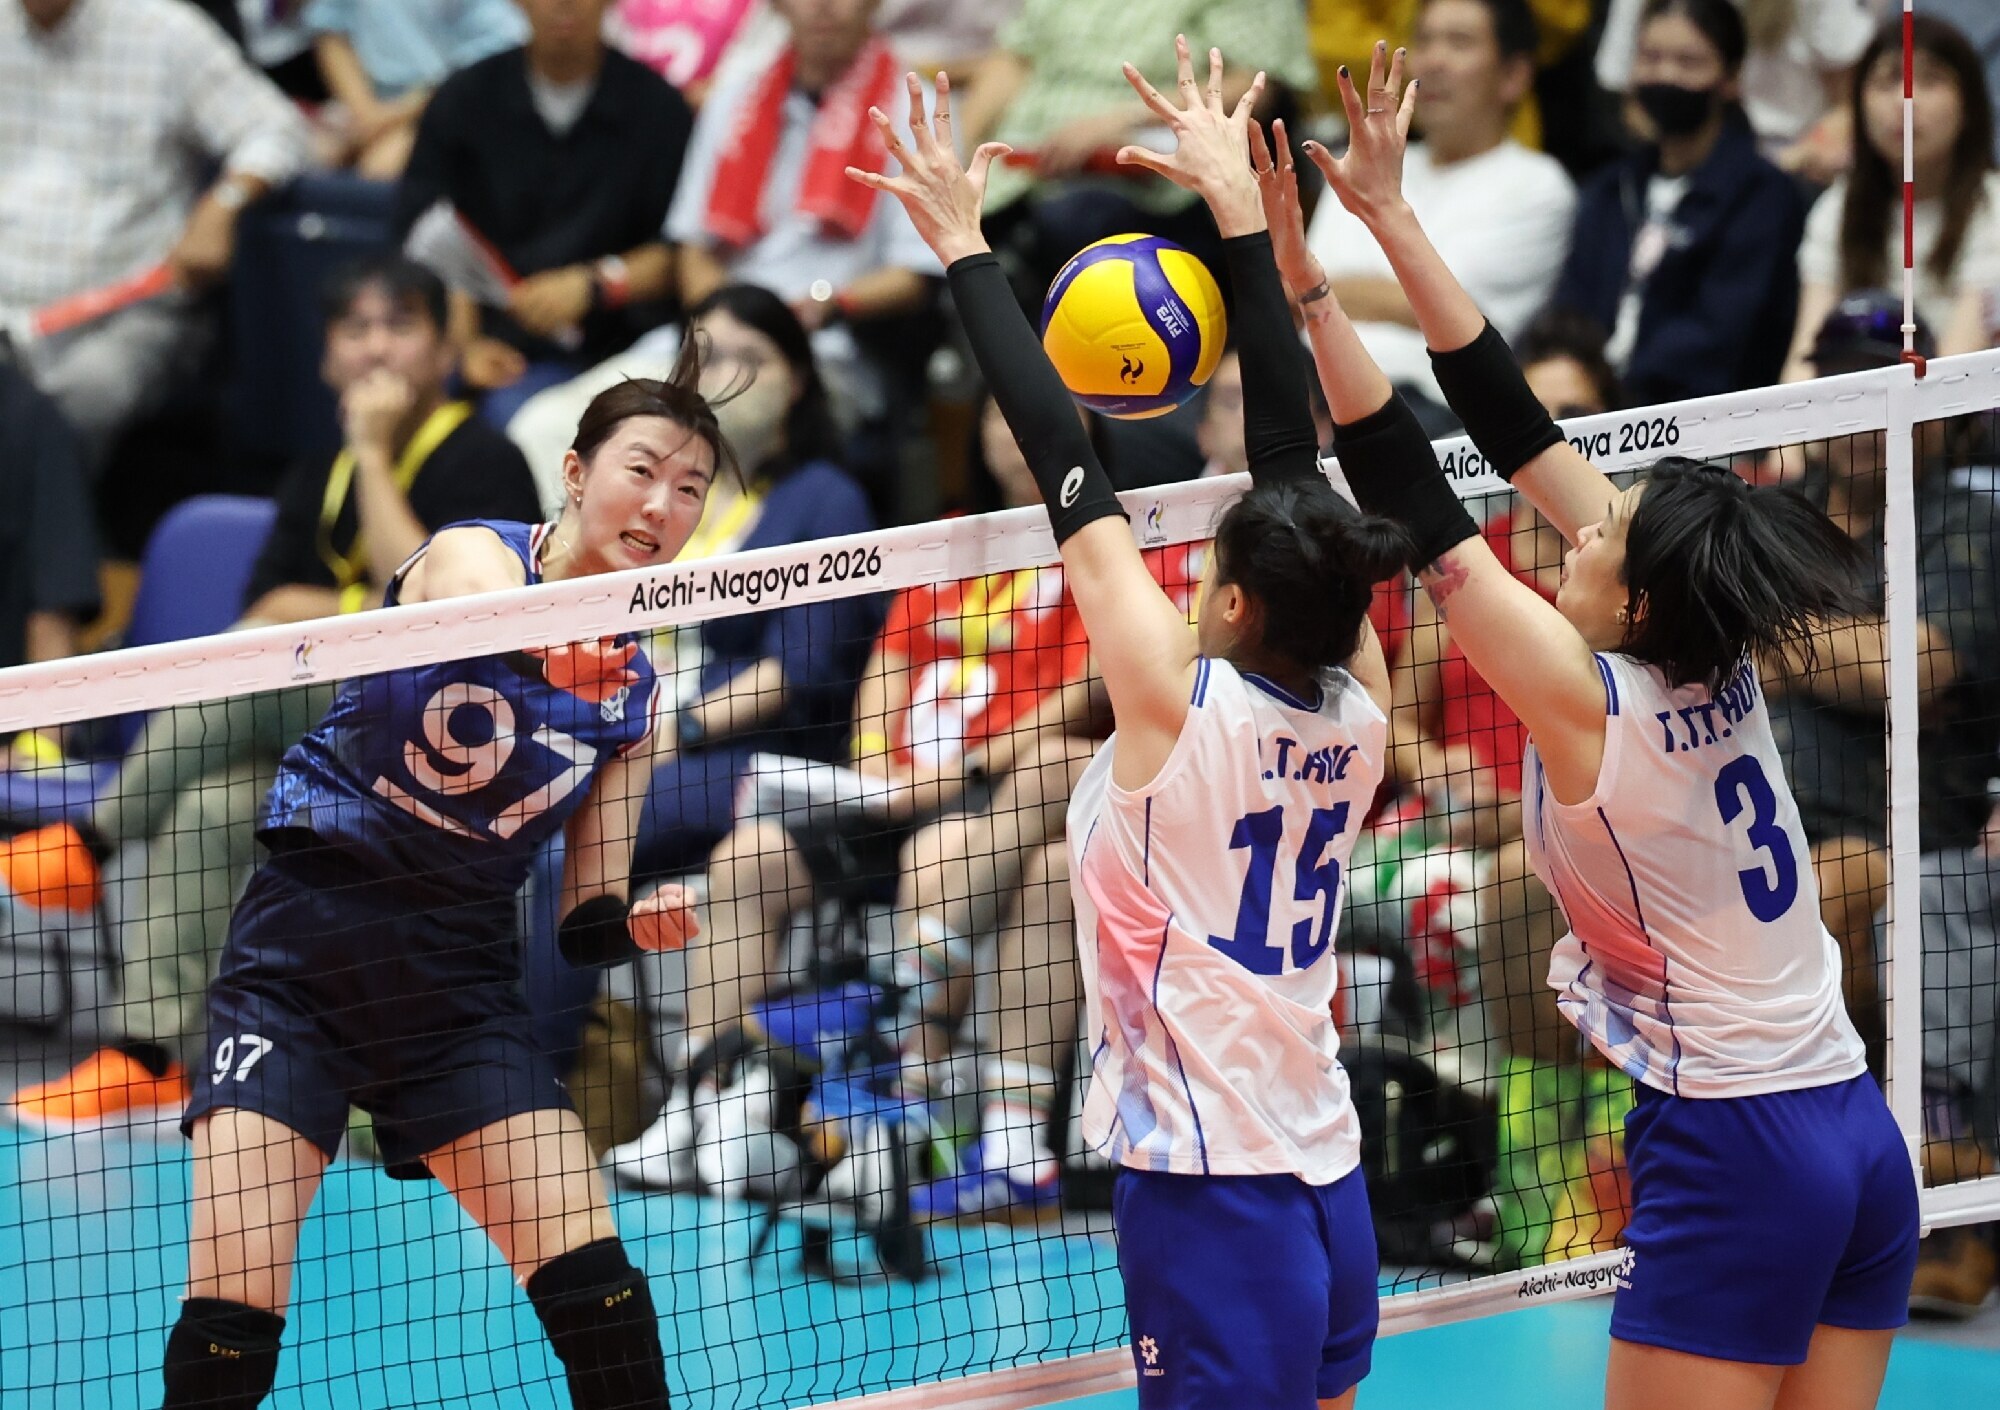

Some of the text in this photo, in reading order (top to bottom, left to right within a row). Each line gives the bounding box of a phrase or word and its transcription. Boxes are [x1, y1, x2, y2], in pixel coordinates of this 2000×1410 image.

[1156, 304, 1182, 338] FIVB
[1443, 416, 1680, 480] Aicoya 2026
[628, 545, 882, 614] Aichi-Nagoya 2026
[403, 682, 598, 841] 97
[1714, 754, 1798, 923] 3
[1207, 800, 1351, 976] 15
[212, 1033, 274, 1086] 97
